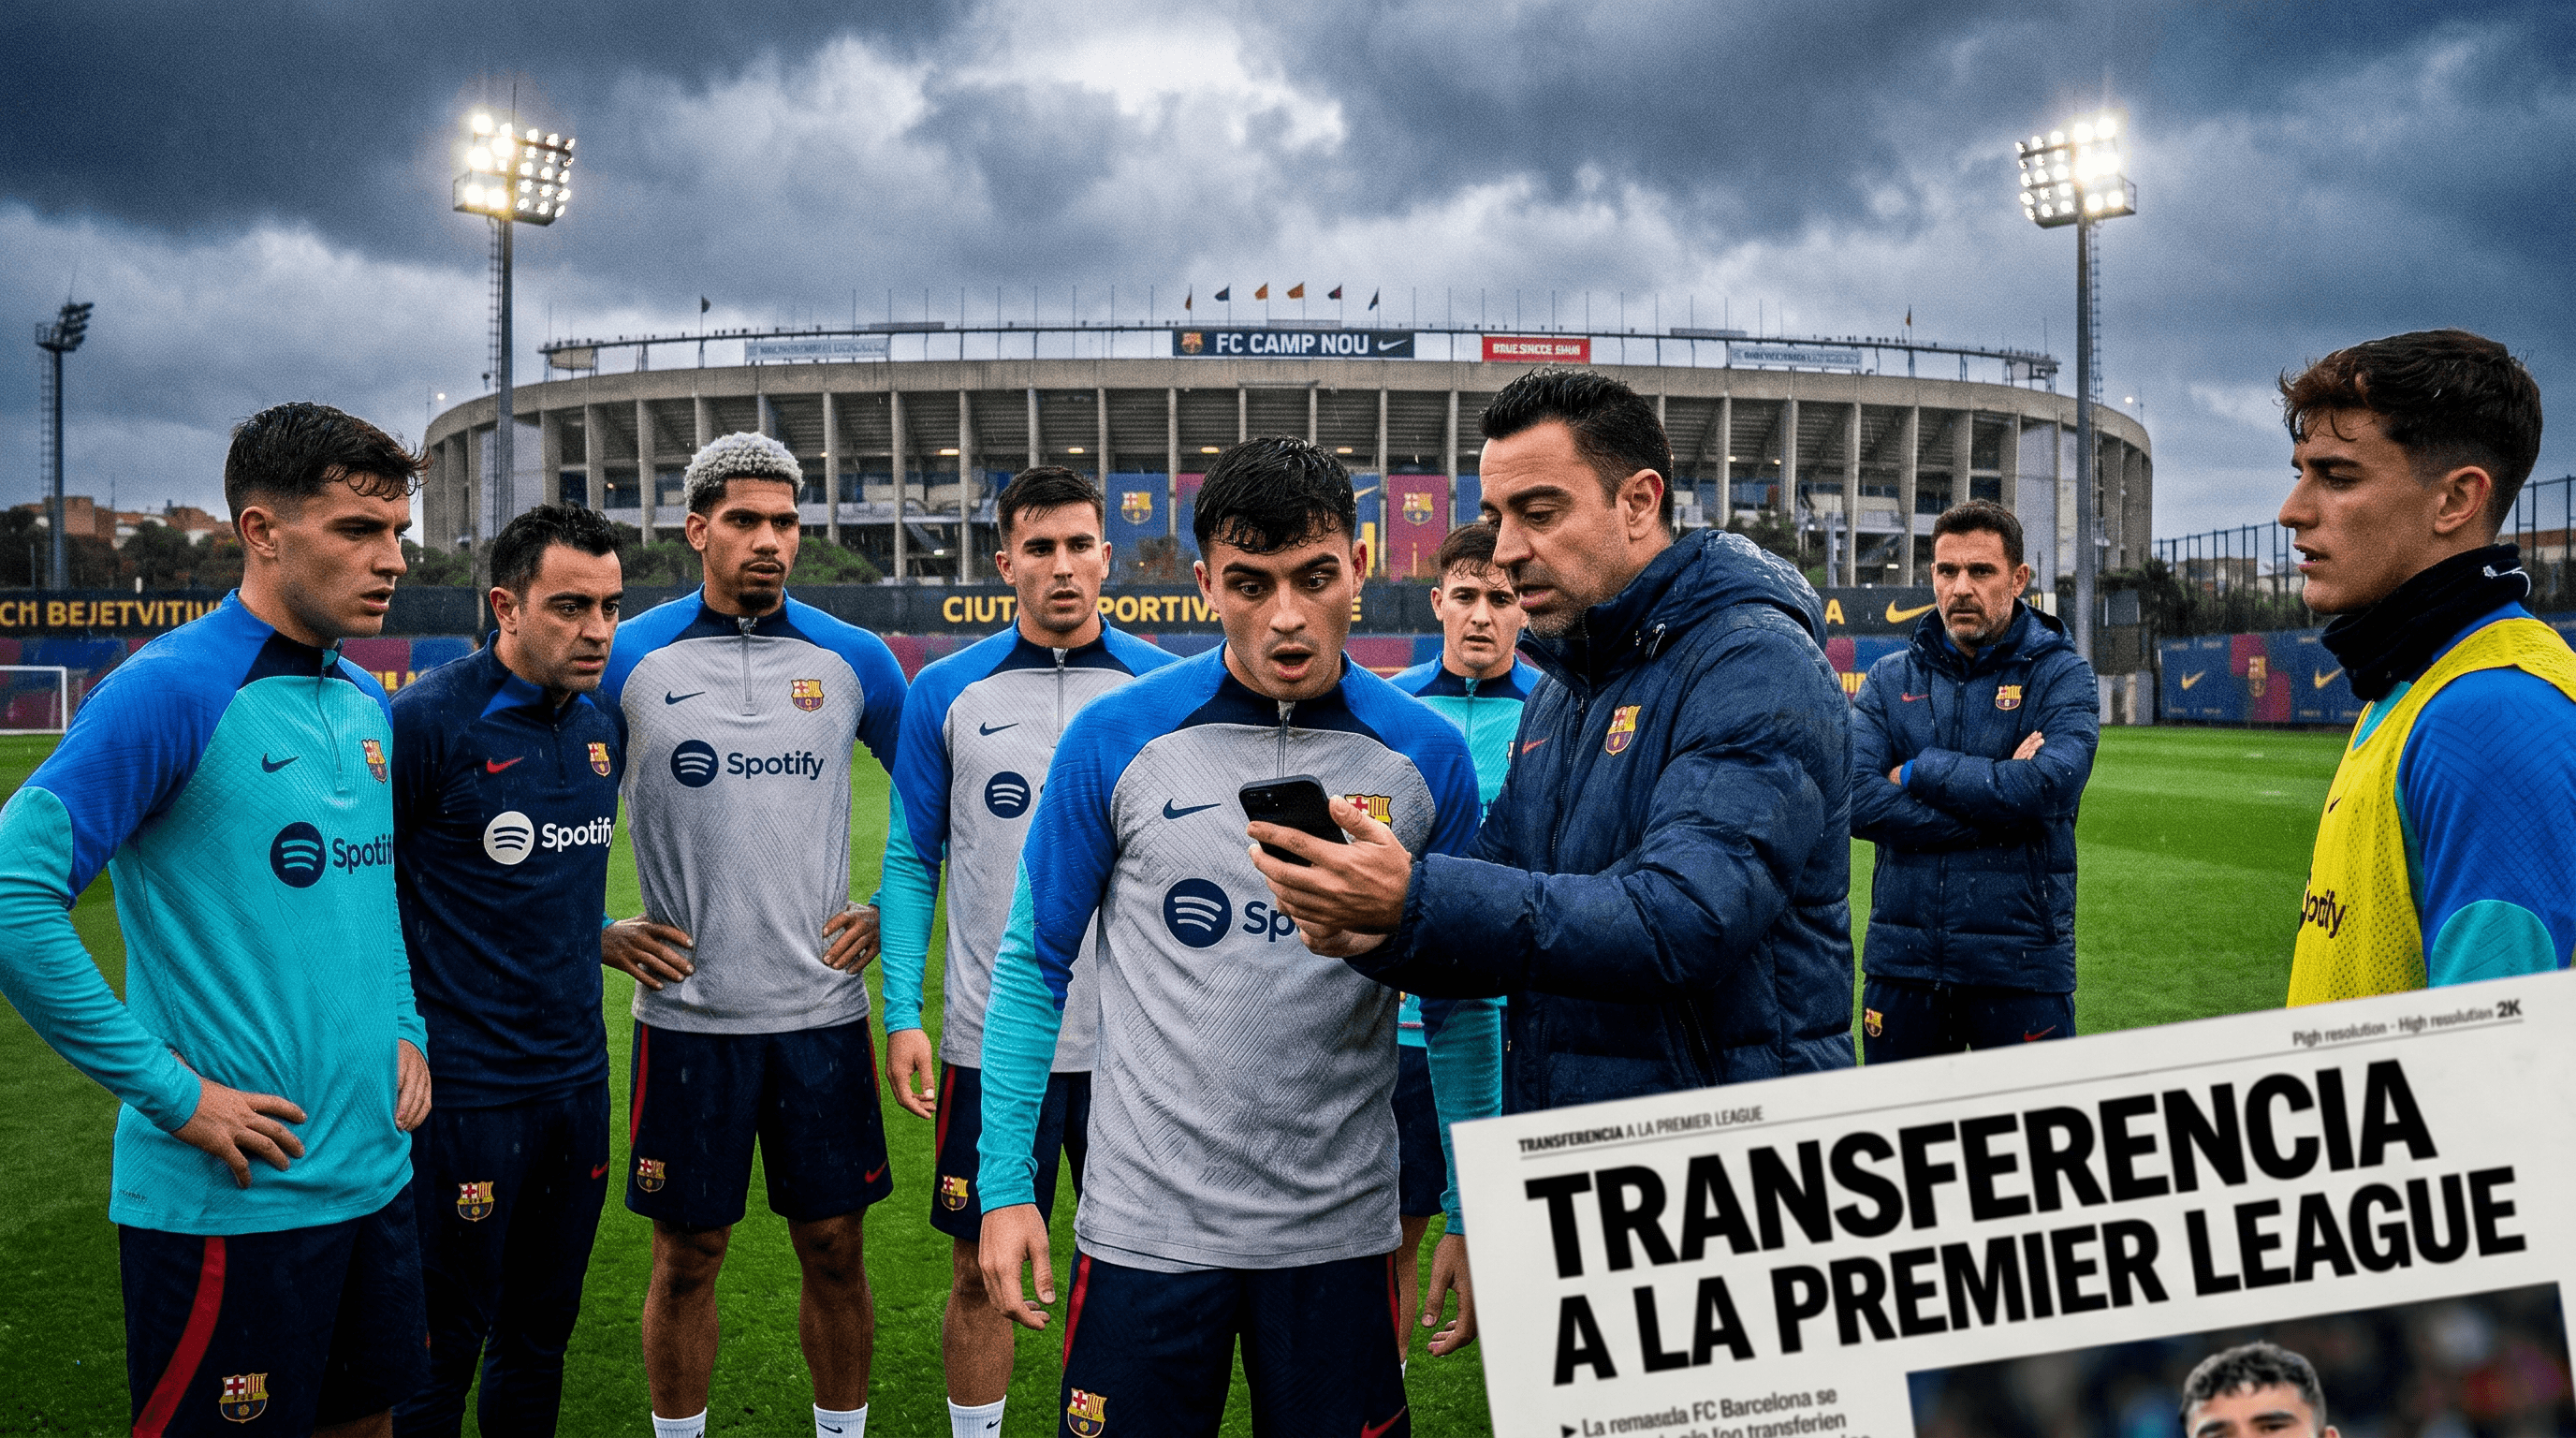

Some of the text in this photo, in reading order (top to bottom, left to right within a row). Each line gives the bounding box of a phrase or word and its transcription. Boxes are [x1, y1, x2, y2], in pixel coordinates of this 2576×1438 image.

[1216, 333, 1369, 355] FC CAMP NOU
[943, 595, 1017, 623] CIUT
[1097, 595, 1220, 623] PORTIV
[727, 750, 824, 780] Spotify
[542, 816, 616, 853] Spotify
[1242, 901, 1300, 943] Sp
[2397, 1015, 2427, 1034] High
[2496, 998, 2523, 1018] 2K
[1518, 1104, 1764, 1152] TRANSFERENCIA A LA PREMIER LEAGUE
[1524, 1059, 2438, 1279] TRANSFERENCIA
[1554, 1165, 2527, 1386] A LA PREMIER LEAGUE
[1582, 1418, 1605, 1437] La
[1692, 1400, 1717, 1422] FC
[1720, 1391, 1812, 1419] Barcelona
[1816, 1387, 1837, 1404] se
